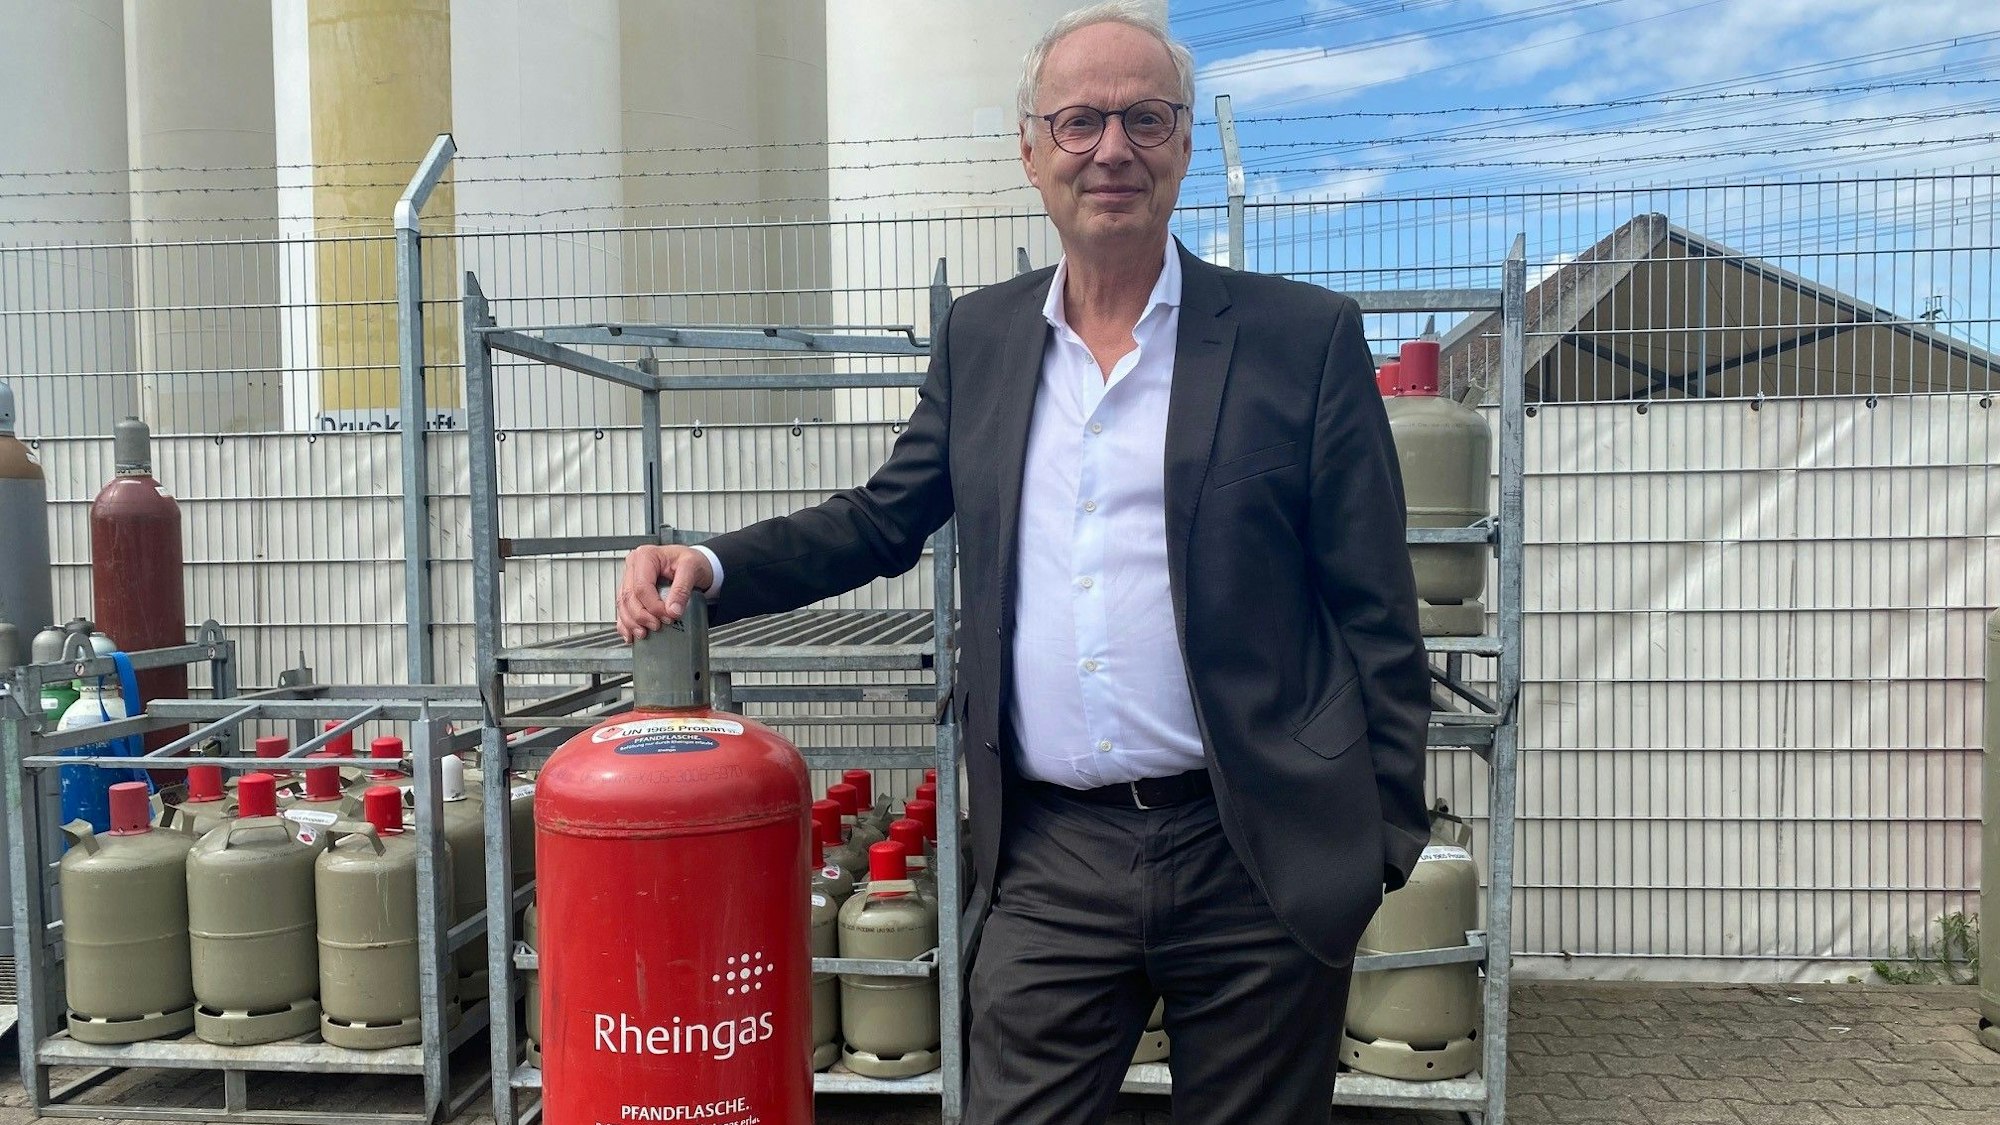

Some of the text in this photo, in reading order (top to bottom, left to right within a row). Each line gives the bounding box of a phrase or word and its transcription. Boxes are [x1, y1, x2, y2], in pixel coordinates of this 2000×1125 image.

[622, 728, 642, 737] UN
[678, 724, 726, 733] Propan
[594, 1011, 774, 1061] Rheingas
[621, 1096, 750, 1121] PFANDFLASCHE.
